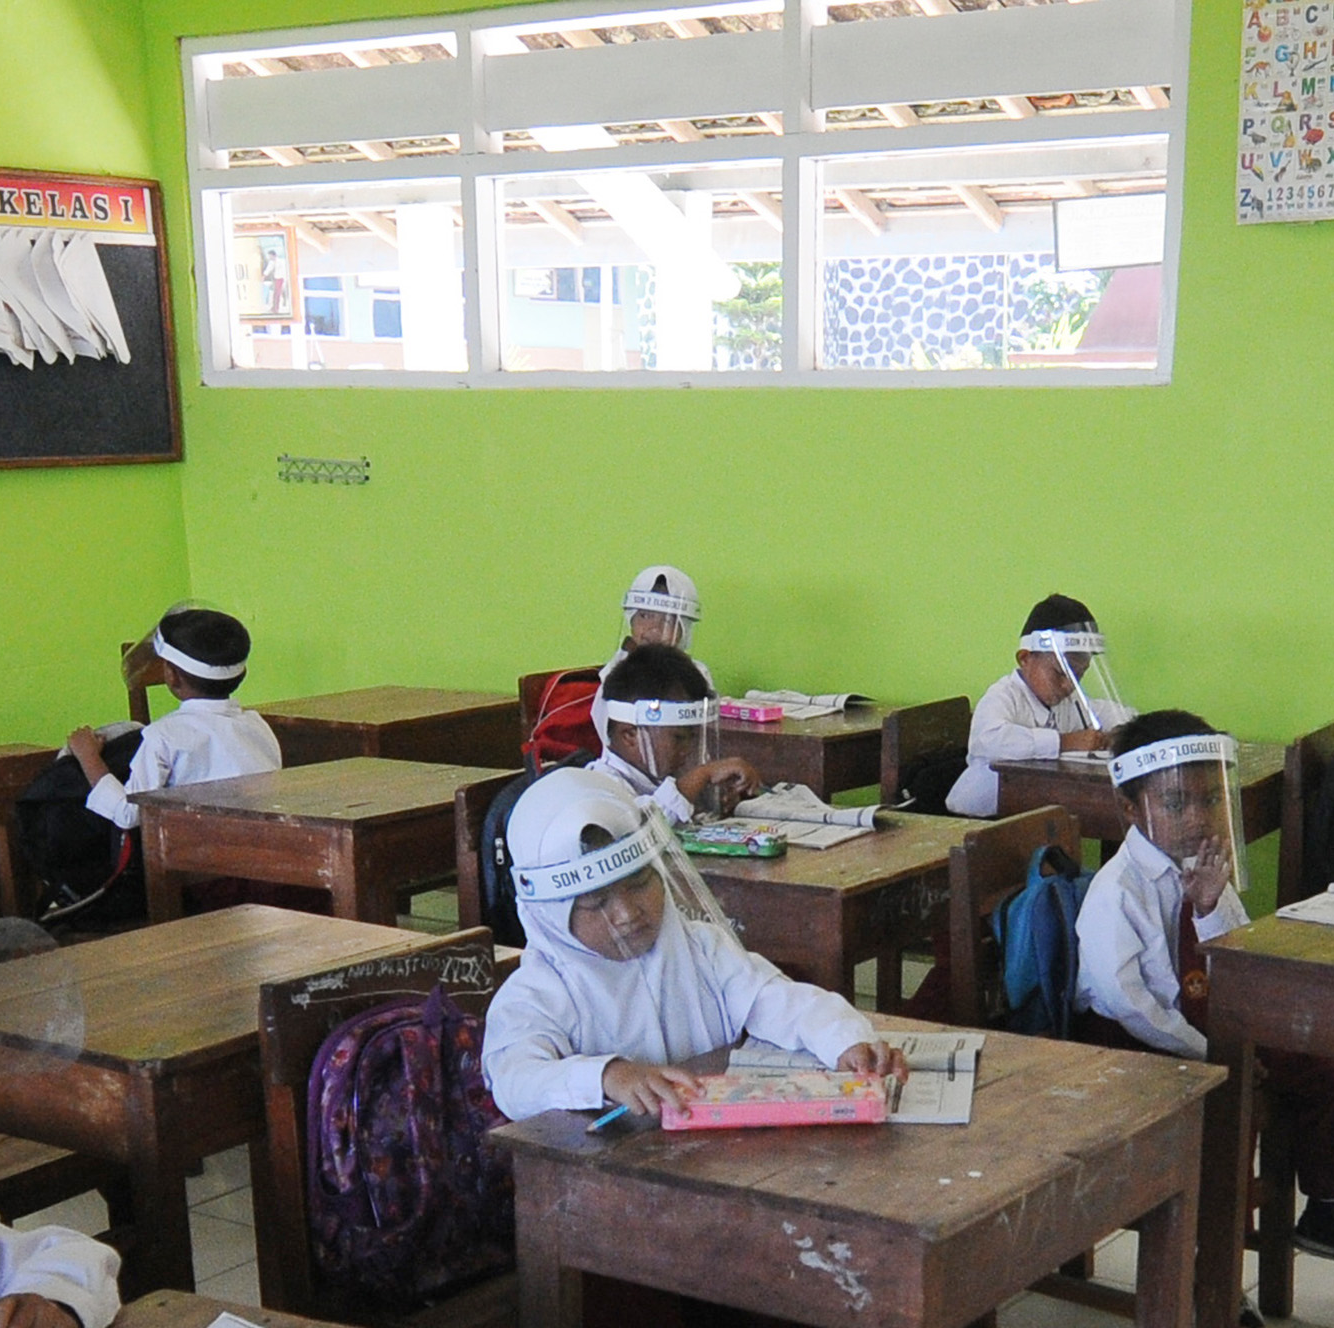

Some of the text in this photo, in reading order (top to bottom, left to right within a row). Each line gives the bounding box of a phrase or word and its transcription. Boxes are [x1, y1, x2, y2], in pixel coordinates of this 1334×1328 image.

[119, 197, 133, 223] I
[678, 708, 697, 719] SDN
[1136, 751, 1158, 768] SDN
[1159, 748, 1168, 760] 2
[551, 868, 582, 889] SDN
[583, 864, 595, 881] 2
